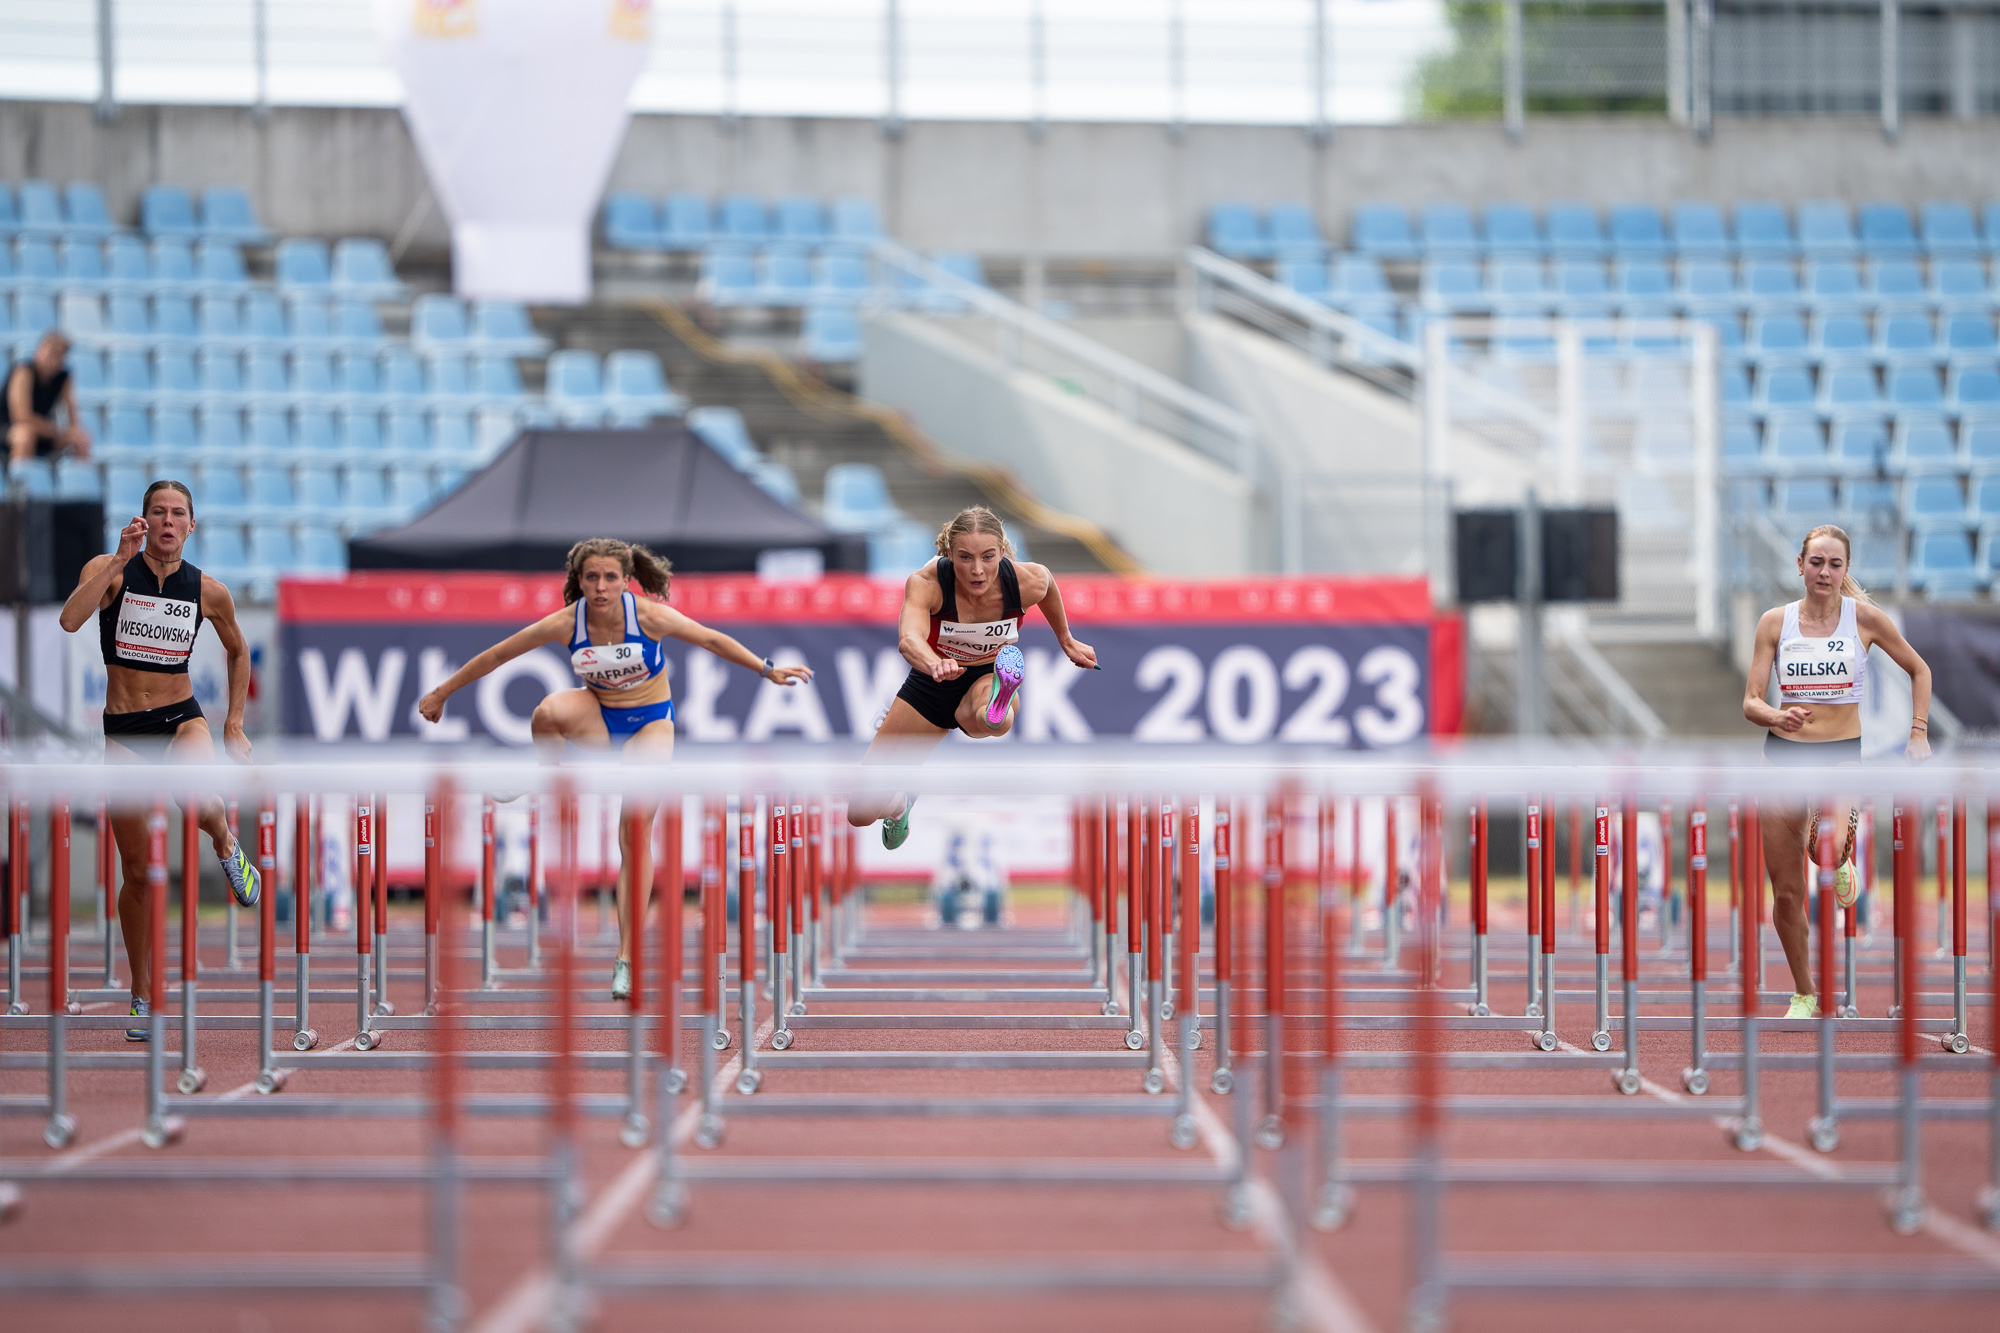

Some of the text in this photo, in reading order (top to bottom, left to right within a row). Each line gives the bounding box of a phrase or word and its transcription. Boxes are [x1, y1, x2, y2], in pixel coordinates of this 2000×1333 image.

[164, 603, 190, 618] 368
[120, 619, 190, 643] WESOŁOWSKA
[984, 622, 1012, 637] 207
[615, 646, 631, 660] 30
[1827, 640, 1844, 652] 92
[121, 650, 164, 662] WŁOCŁAWEK
[1787, 662, 1848, 677] SIELSKA
[1134, 645, 1426, 746] 2023
[776, 818, 784, 842] polanik
